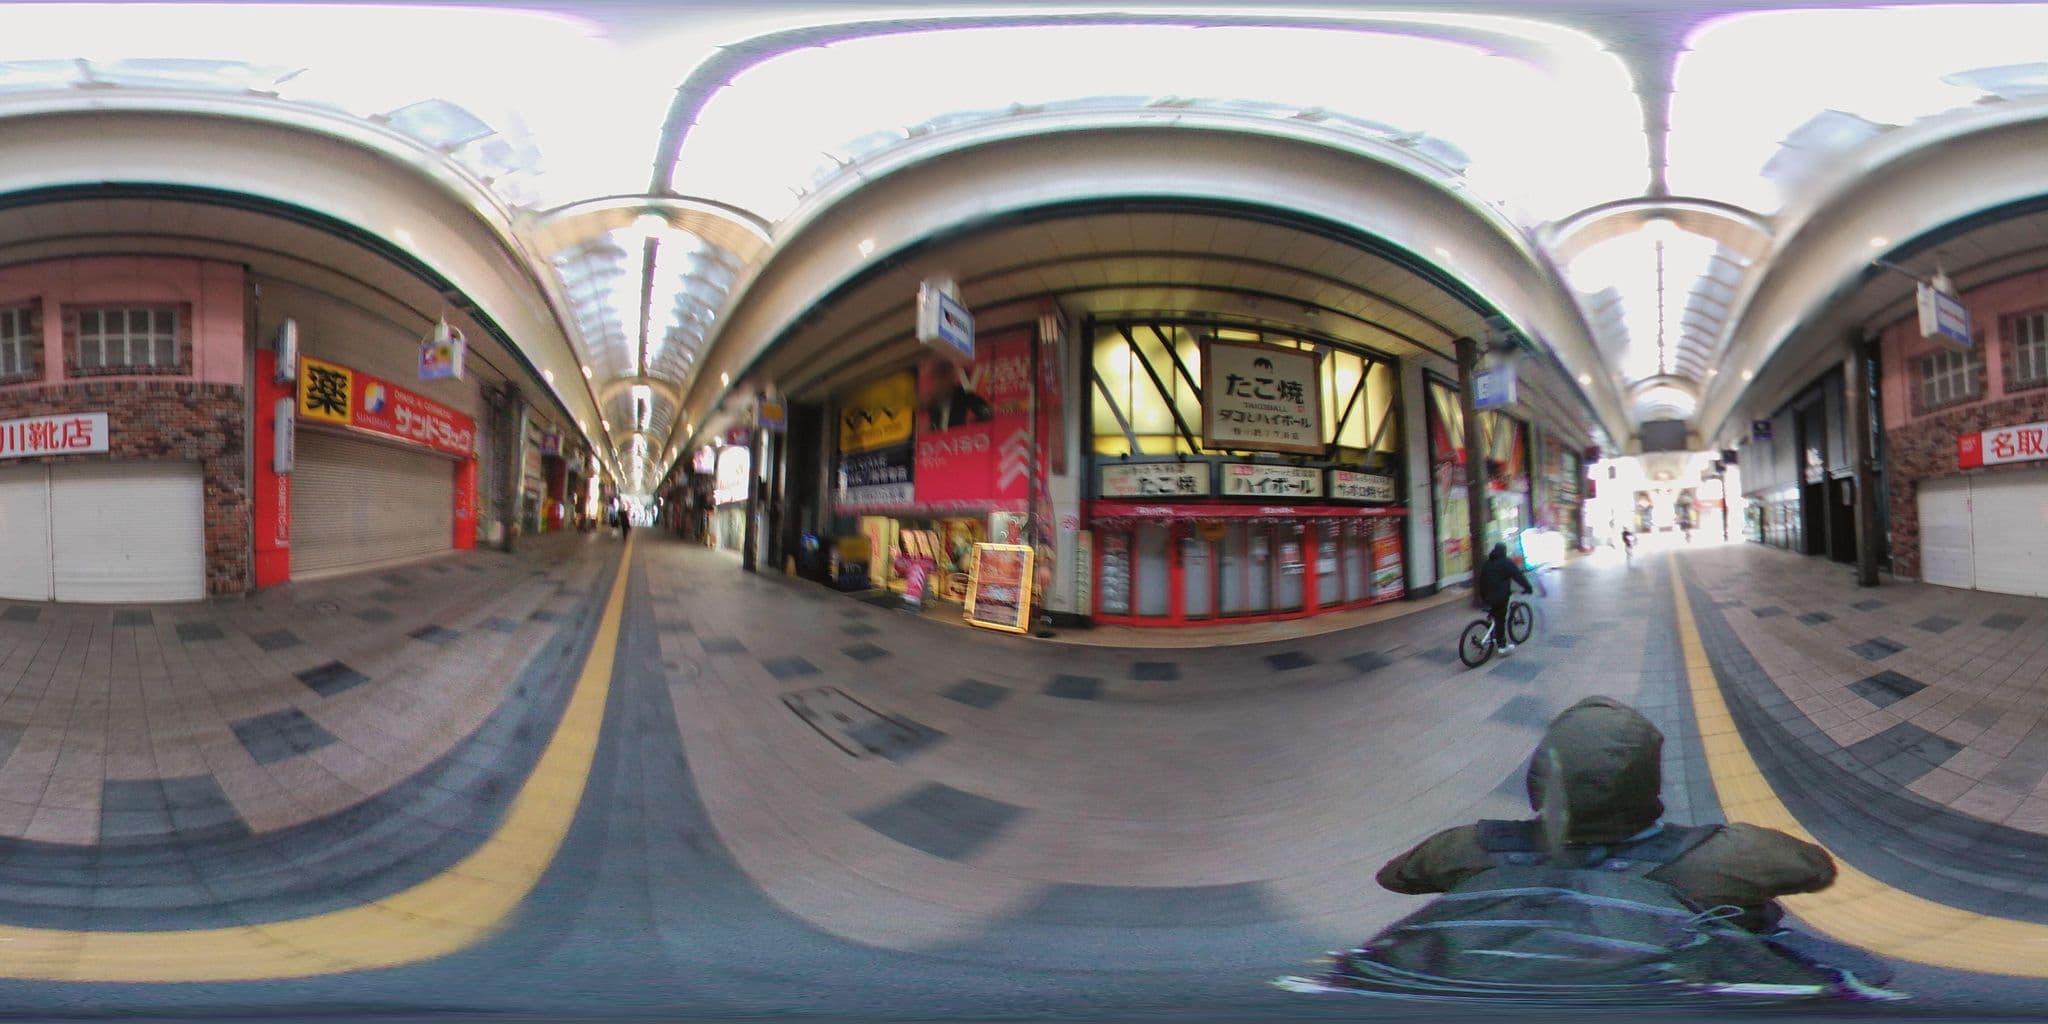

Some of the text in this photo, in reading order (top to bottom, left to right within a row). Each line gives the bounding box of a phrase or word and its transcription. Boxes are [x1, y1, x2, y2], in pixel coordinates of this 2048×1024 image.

[306, 364, 347, 416] 薬
[1225, 374, 1304, 405] たこ焼
[394, 404, 473, 451] サンドラッグ
[1138, 474, 1197, 494] たこ焼
[1232, 477, 1314, 494] ハイボール
